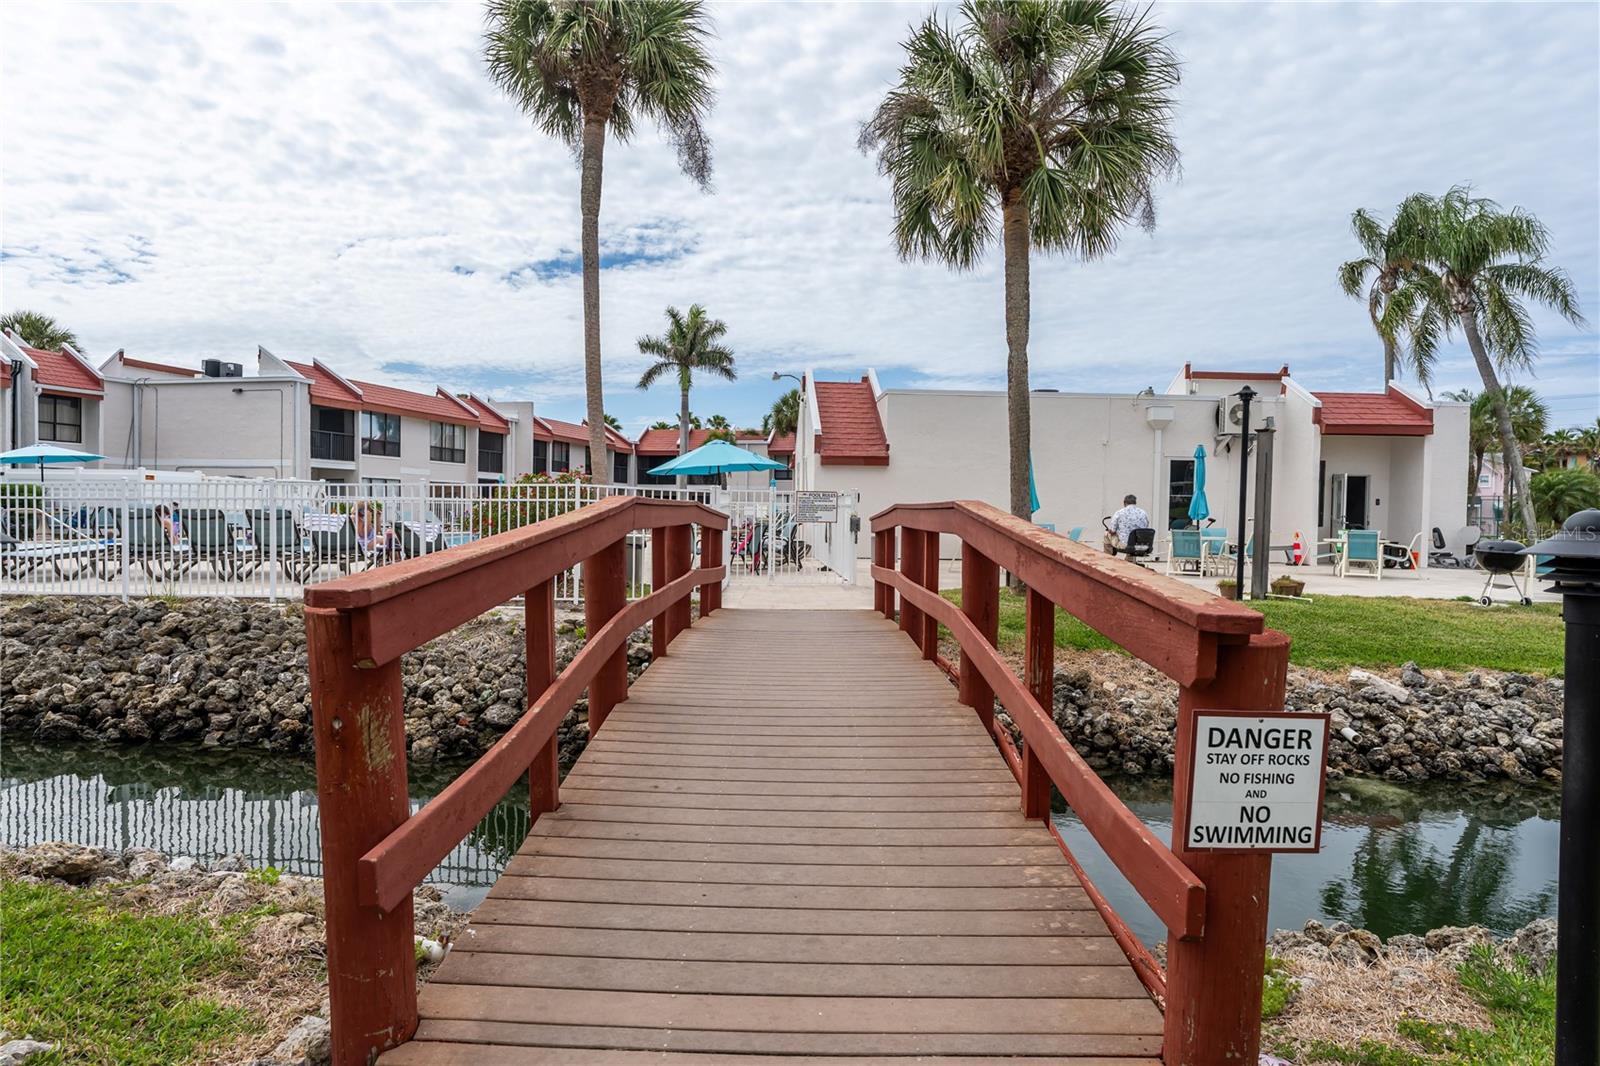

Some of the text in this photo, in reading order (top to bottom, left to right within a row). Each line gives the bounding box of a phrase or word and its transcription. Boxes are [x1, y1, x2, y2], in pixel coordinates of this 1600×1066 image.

[1208, 727, 1312, 750] DANGER
[1206, 753, 1310, 766] STAY OFF ROCKS
[1219, 772, 1295, 785] NO FISHING
[1245, 790, 1267, 799] AND
[1239, 805, 1271, 824] NO
[1193, 825, 1312, 844] SWIMMING
